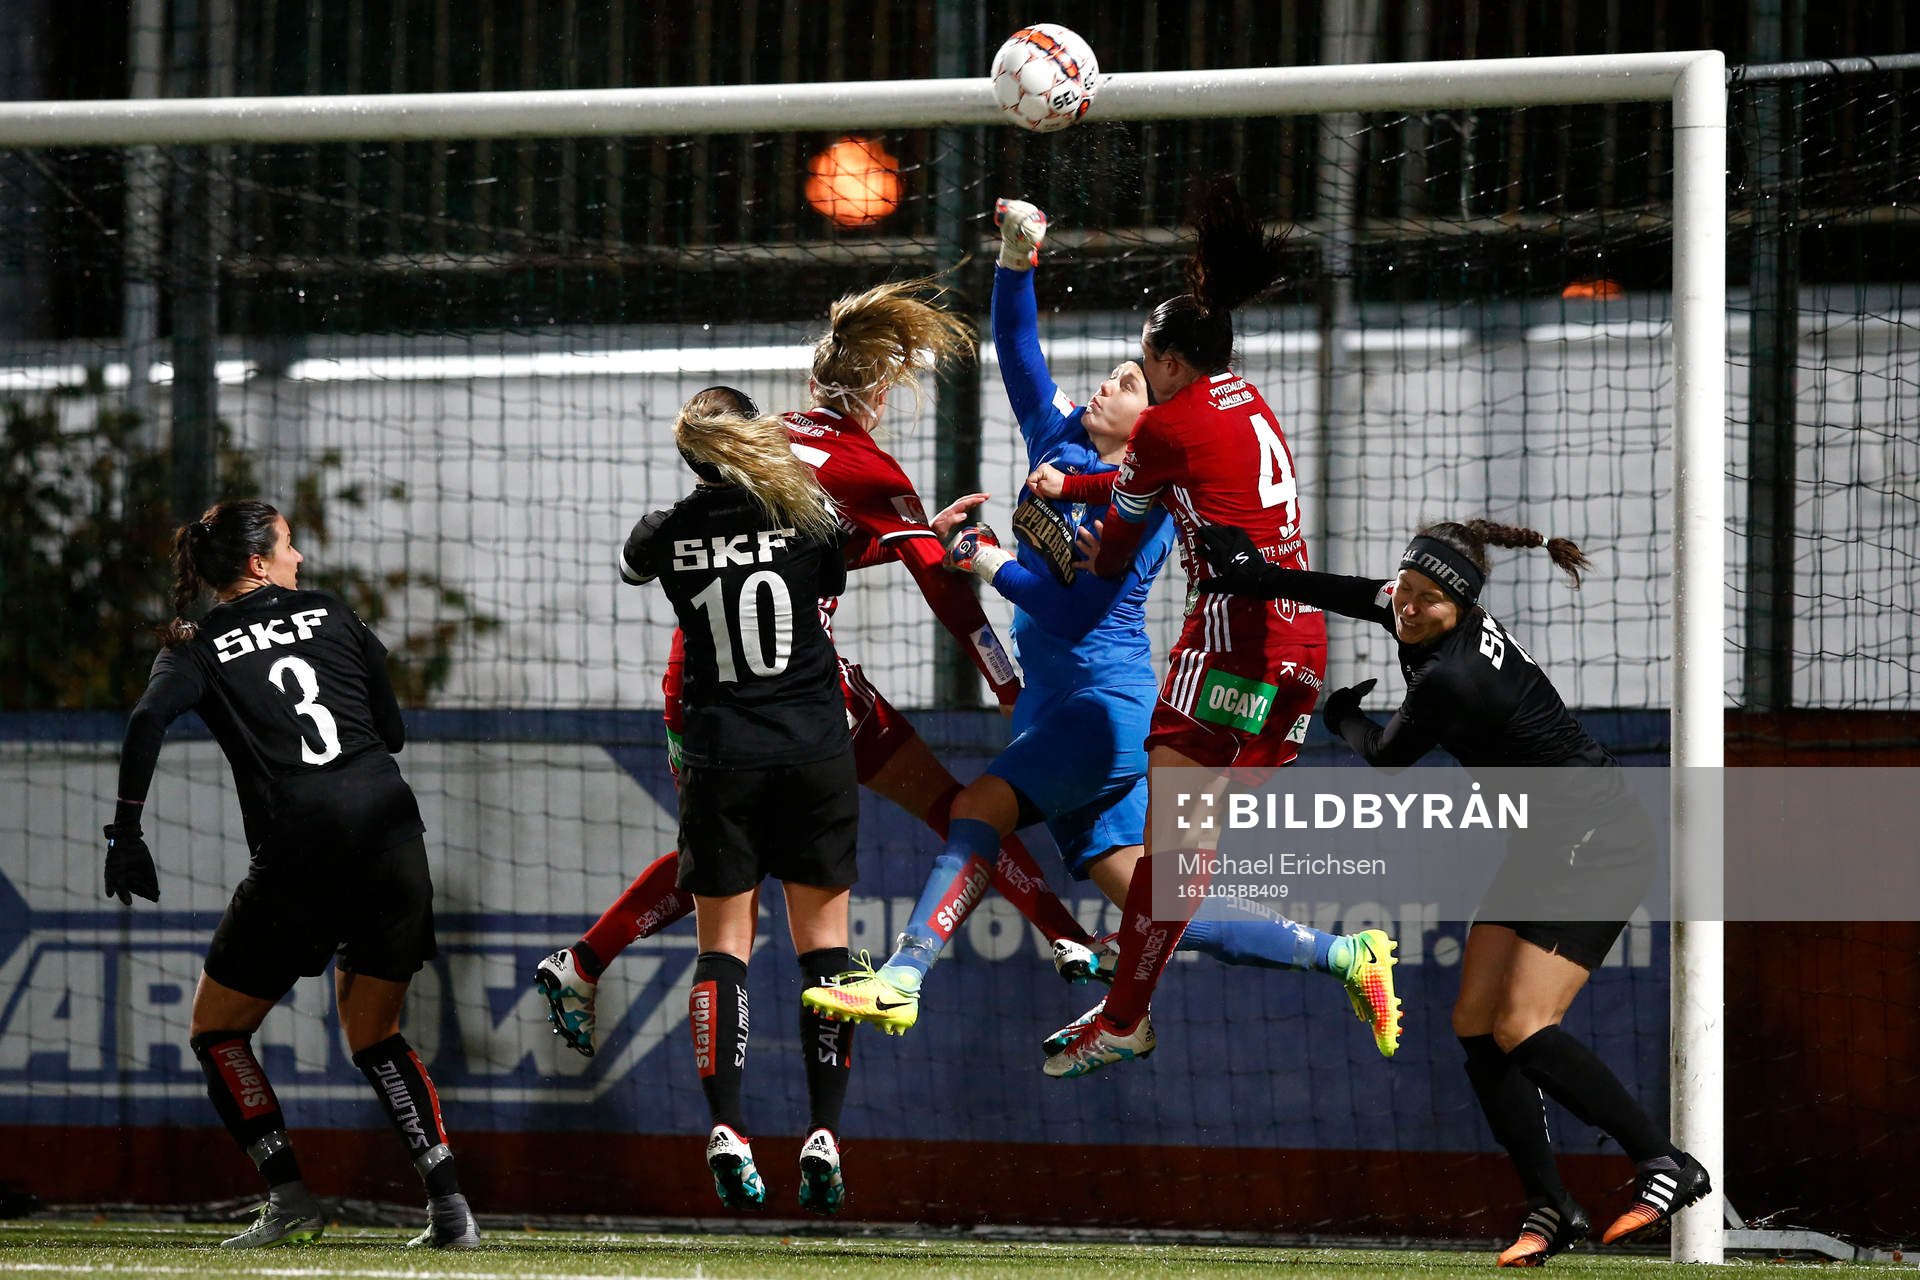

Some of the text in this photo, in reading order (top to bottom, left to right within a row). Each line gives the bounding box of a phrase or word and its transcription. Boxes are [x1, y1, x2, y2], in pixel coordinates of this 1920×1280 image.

[1249, 412, 1298, 523] 4
[1033, 498, 1060, 523] PREMIUM
[673, 528, 796, 571] SKF
[213, 608, 328, 663] SKF
[690, 570, 793, 683] 10
[1479, 608, 1505, 671] SK
[268, 655, 343, 766] 3
[1208, 684, 1269, 722] OCAY!
[937, 863, 990, 932] Stavdal
[733, 983, 749, 1070] SALMING
[218, 1045, 270, 1108] Stavdal
[371, 1060, 431, 1150] SALMING
